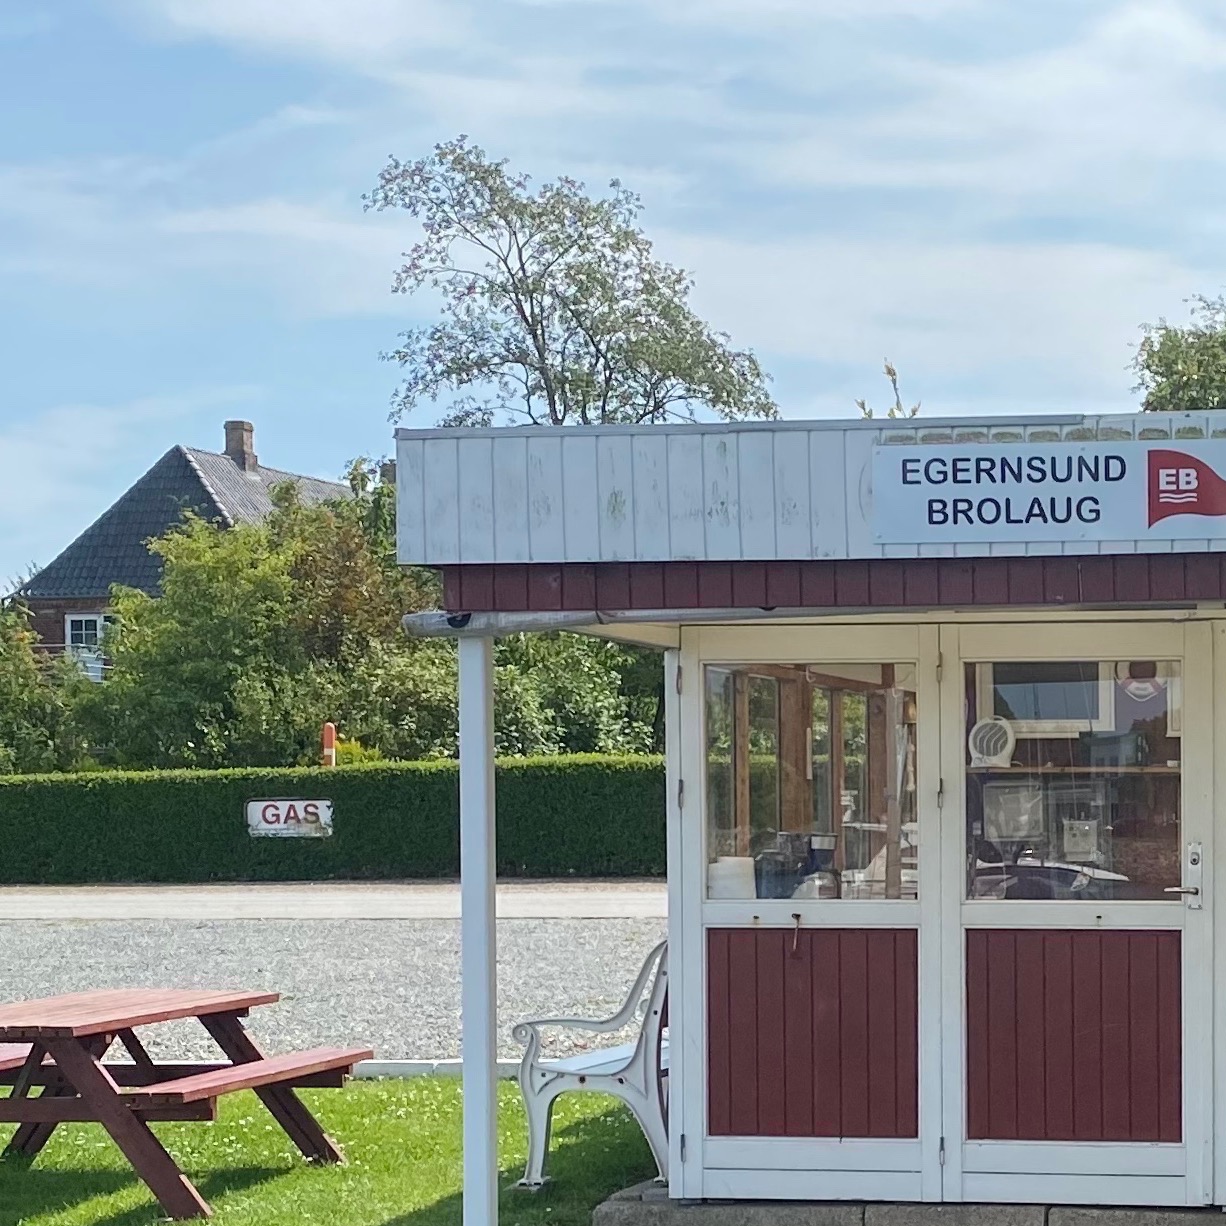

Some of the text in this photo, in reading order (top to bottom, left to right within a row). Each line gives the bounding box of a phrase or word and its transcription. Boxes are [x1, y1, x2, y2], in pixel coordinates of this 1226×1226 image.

[902, 455, 1127, 485] EGERNSUND
[1159, 468, 1198, 490] EB
[927, 496, 1101, 525] BROLAUG
[261, 803, 320, 825] GAS
